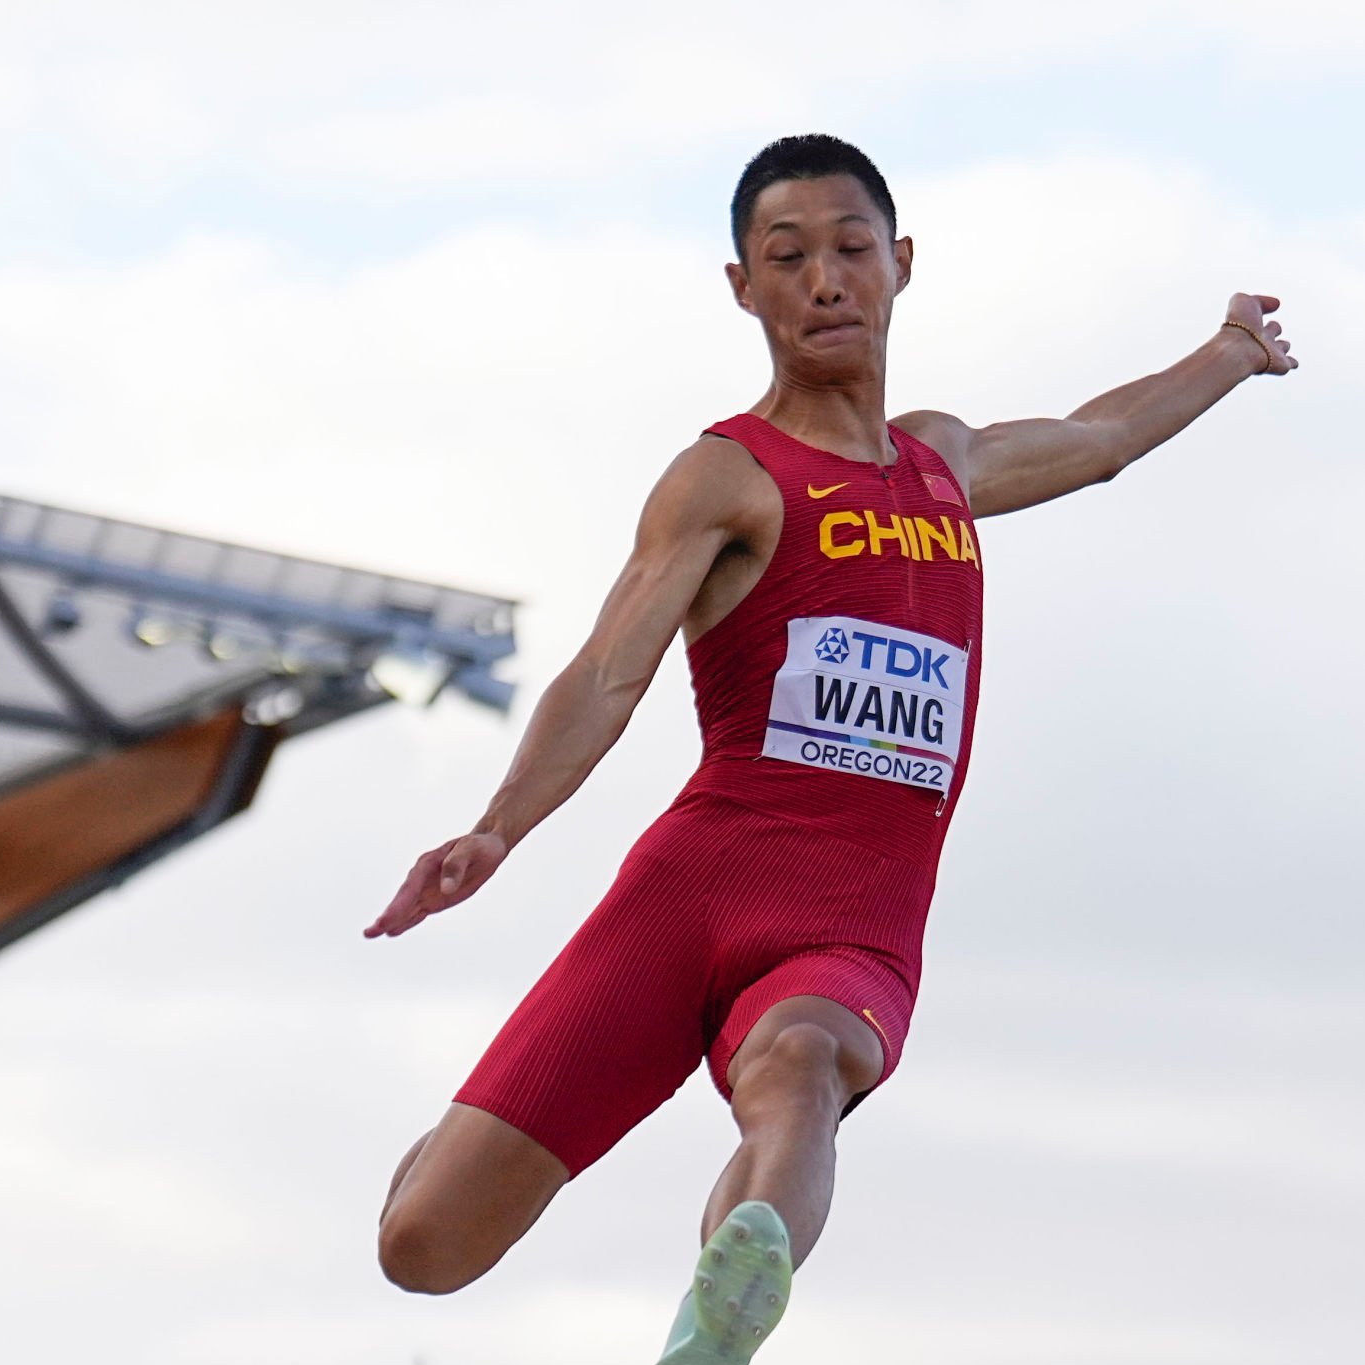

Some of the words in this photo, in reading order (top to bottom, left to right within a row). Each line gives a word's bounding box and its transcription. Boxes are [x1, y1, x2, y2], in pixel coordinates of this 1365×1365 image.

[819, 510, 980, 569] CHINA
[852, 631, 950, 690] TDK
[815, 675, 943, 745] WANG
[800, 741, 943, 786] OREGON22
